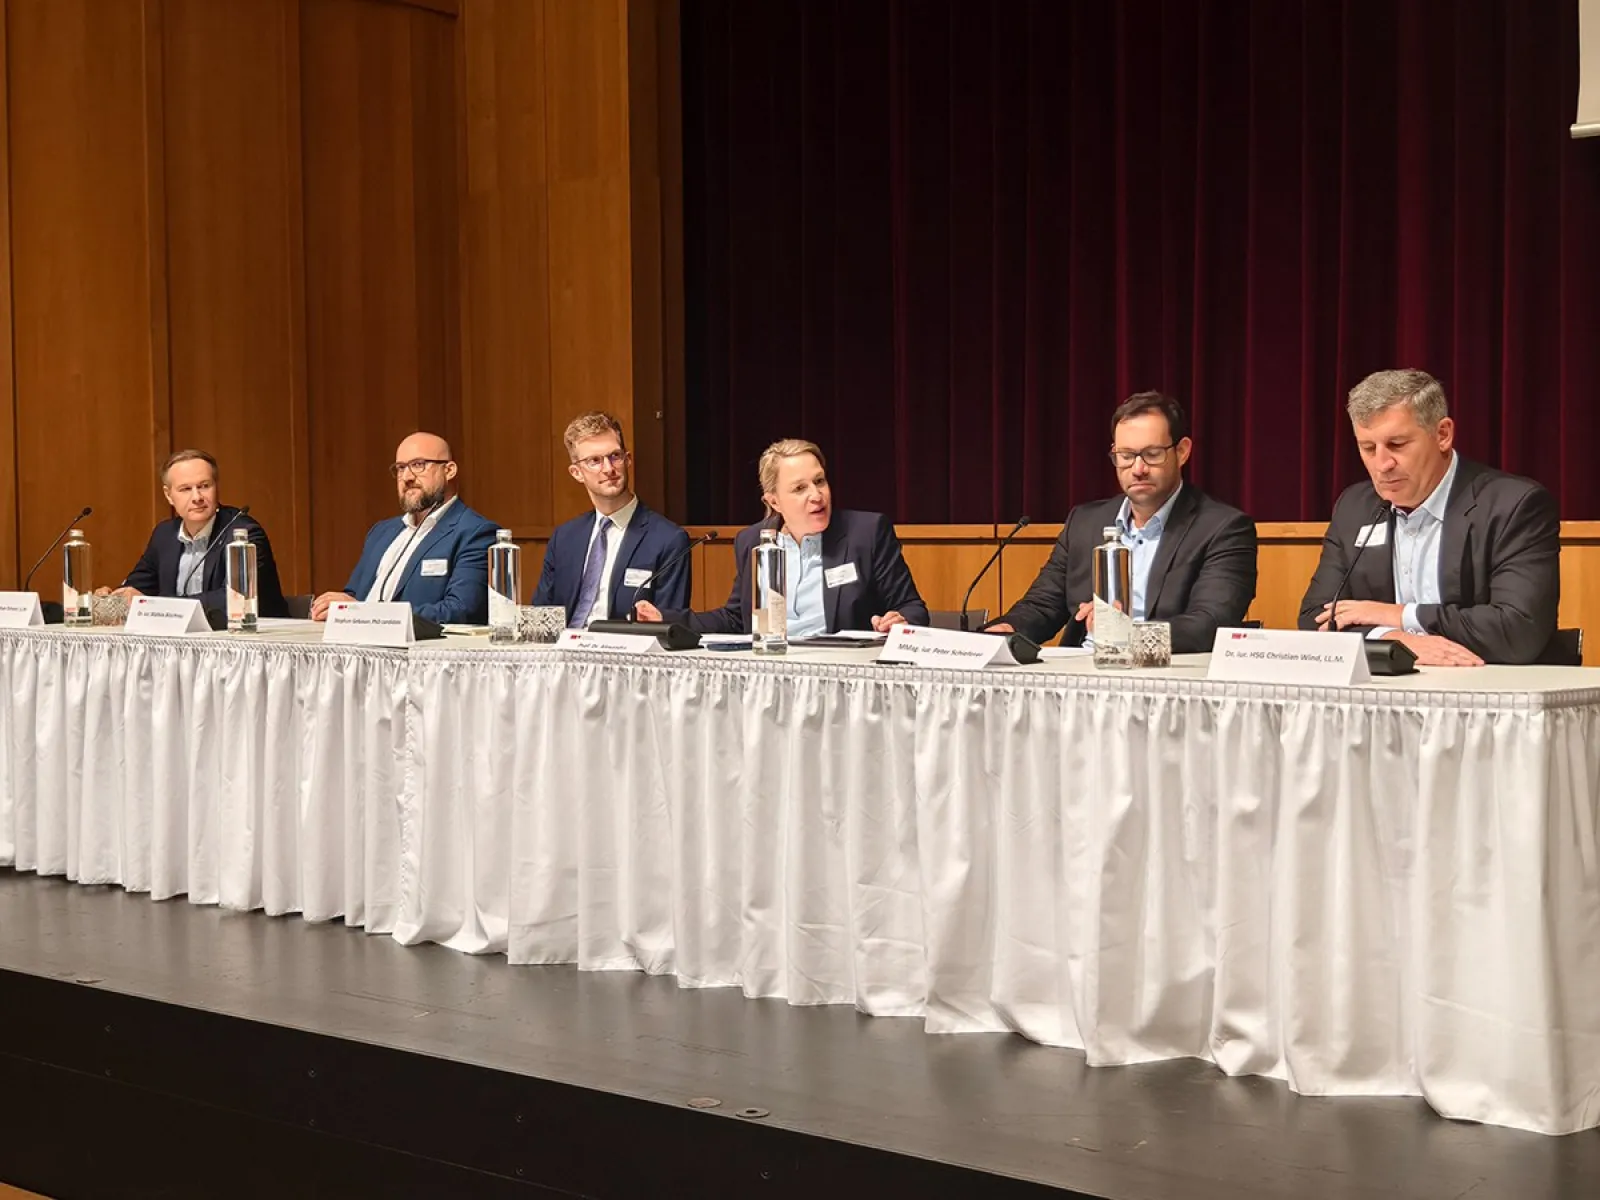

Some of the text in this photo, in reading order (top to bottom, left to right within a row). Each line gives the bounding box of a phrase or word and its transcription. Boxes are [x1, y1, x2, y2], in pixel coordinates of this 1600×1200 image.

[932, 647, 950, 656] Peter
[1224, 650, 1235, 658] Dr.
[1249, 651, 1265, 660] HSG
[1266, 652, 1300, 661] Christian
[1300, 654, 1323, 663] Wind,
[1323, 655, 1345, 664] LL.M.
